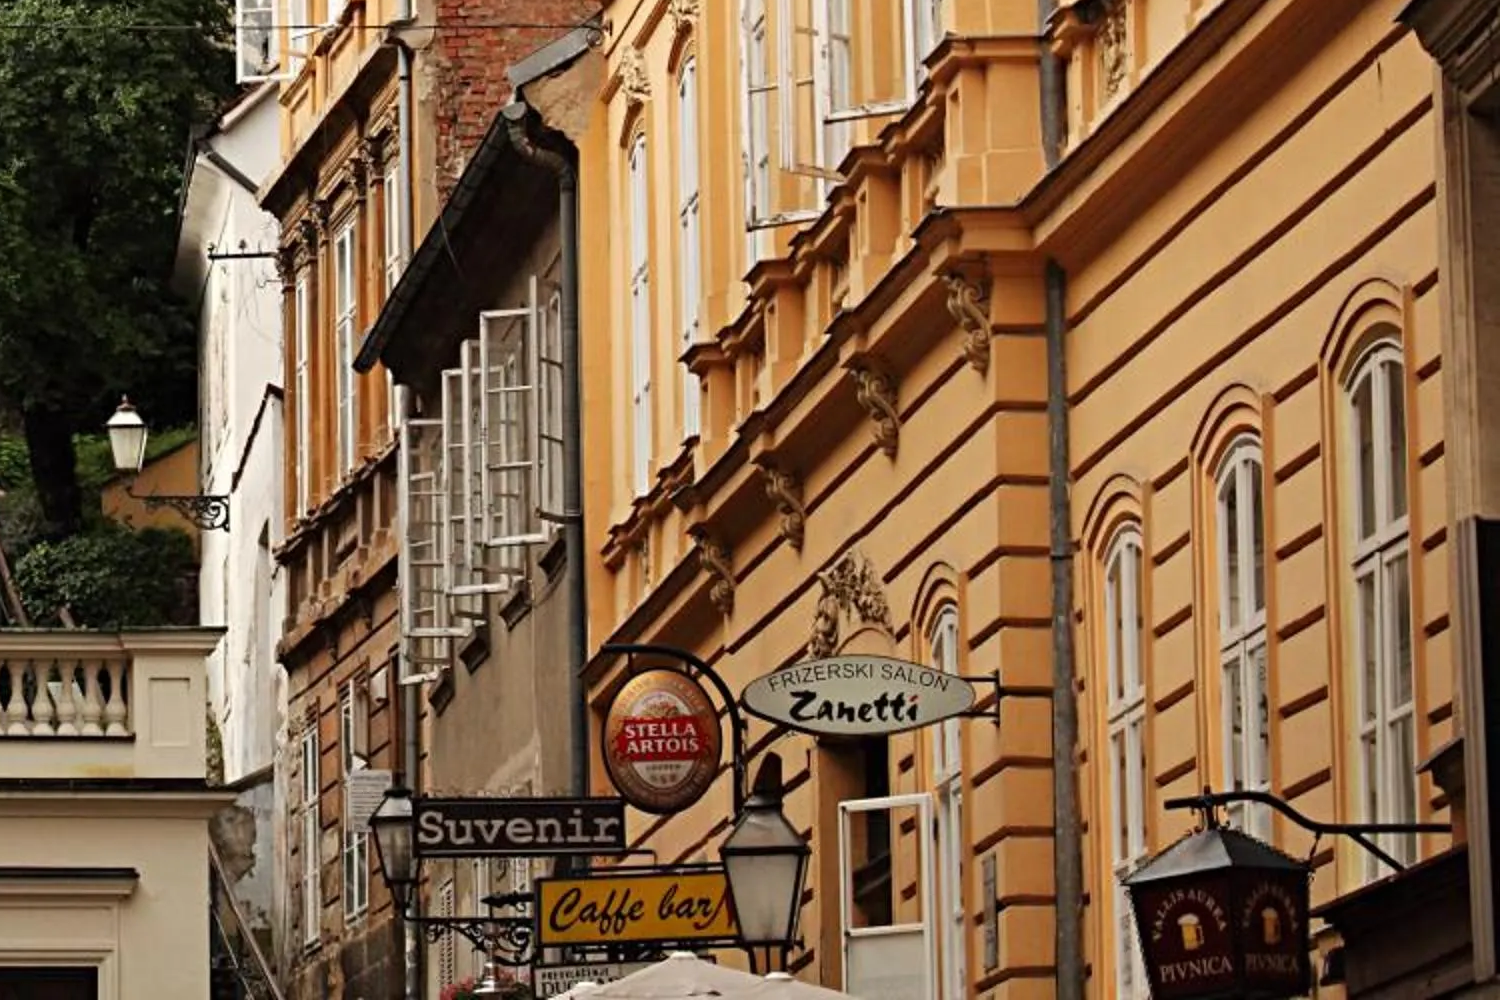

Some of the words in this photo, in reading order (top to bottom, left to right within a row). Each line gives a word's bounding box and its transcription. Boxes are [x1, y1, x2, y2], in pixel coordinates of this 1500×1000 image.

[767, 663, 874, 692] FRIZERSKI
[880, 663, 950, 692] SALON
[789, 689, 919, 722] Zanetti
[624, 722, 697, 739] STELLA
[626, 738, 700, 754] ARTOIS
[417, 808, 620, 845] Suvenir
[549, 887, 645, 935] Caffe
[657, 883, 730, 930] bar
[1158, 955, 1233, 984] PIVNICA
